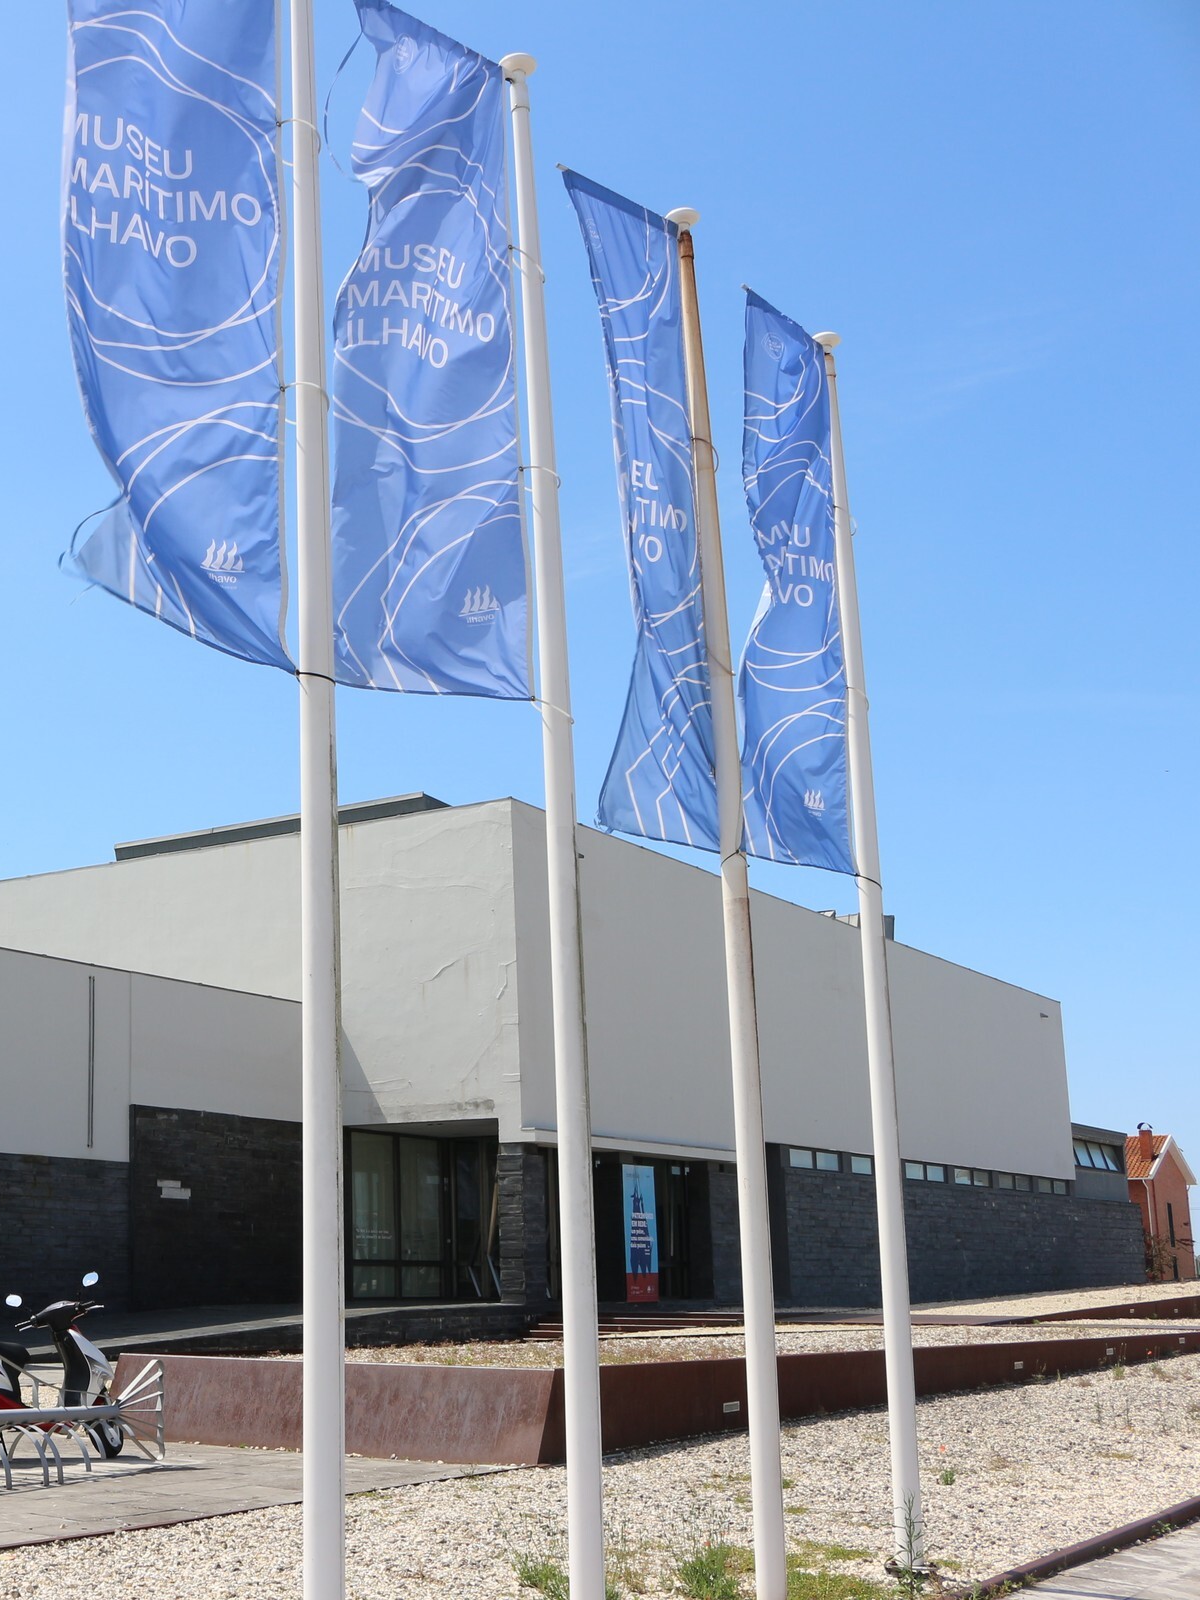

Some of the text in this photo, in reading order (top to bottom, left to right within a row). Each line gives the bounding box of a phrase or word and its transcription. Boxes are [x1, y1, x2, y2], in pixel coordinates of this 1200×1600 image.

[70, 195, 198, 268] LHAVO
[346, 310, 449, 369] ÍLHAVO
[347, 279, 495, 343] MARÍTIMO
